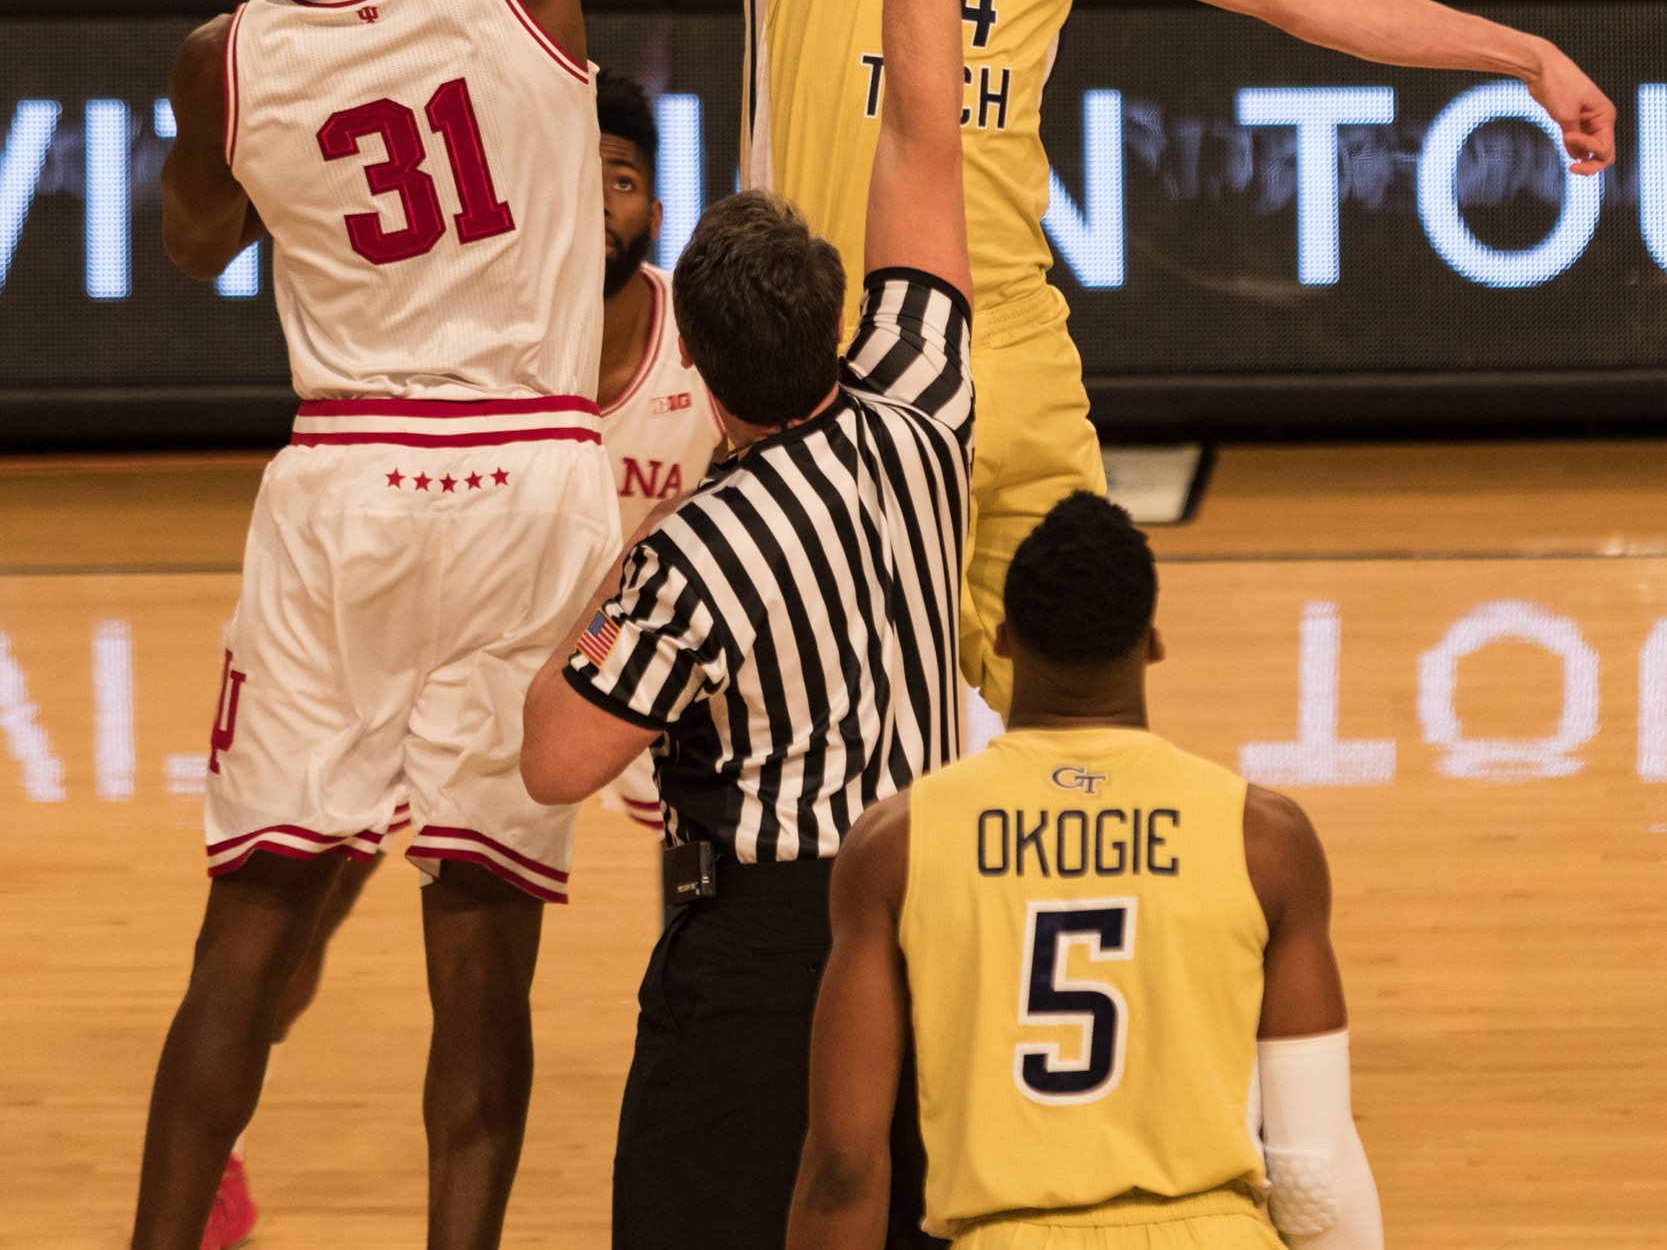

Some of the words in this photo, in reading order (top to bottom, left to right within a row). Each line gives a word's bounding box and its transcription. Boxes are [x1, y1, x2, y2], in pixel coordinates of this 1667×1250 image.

[315, 76, 517, 267] 31
[1234, 79, 1667, 290] TO
[977, 807, 1181, 878] OKOGIE
[1012, 896, 1139, 1107] 5
